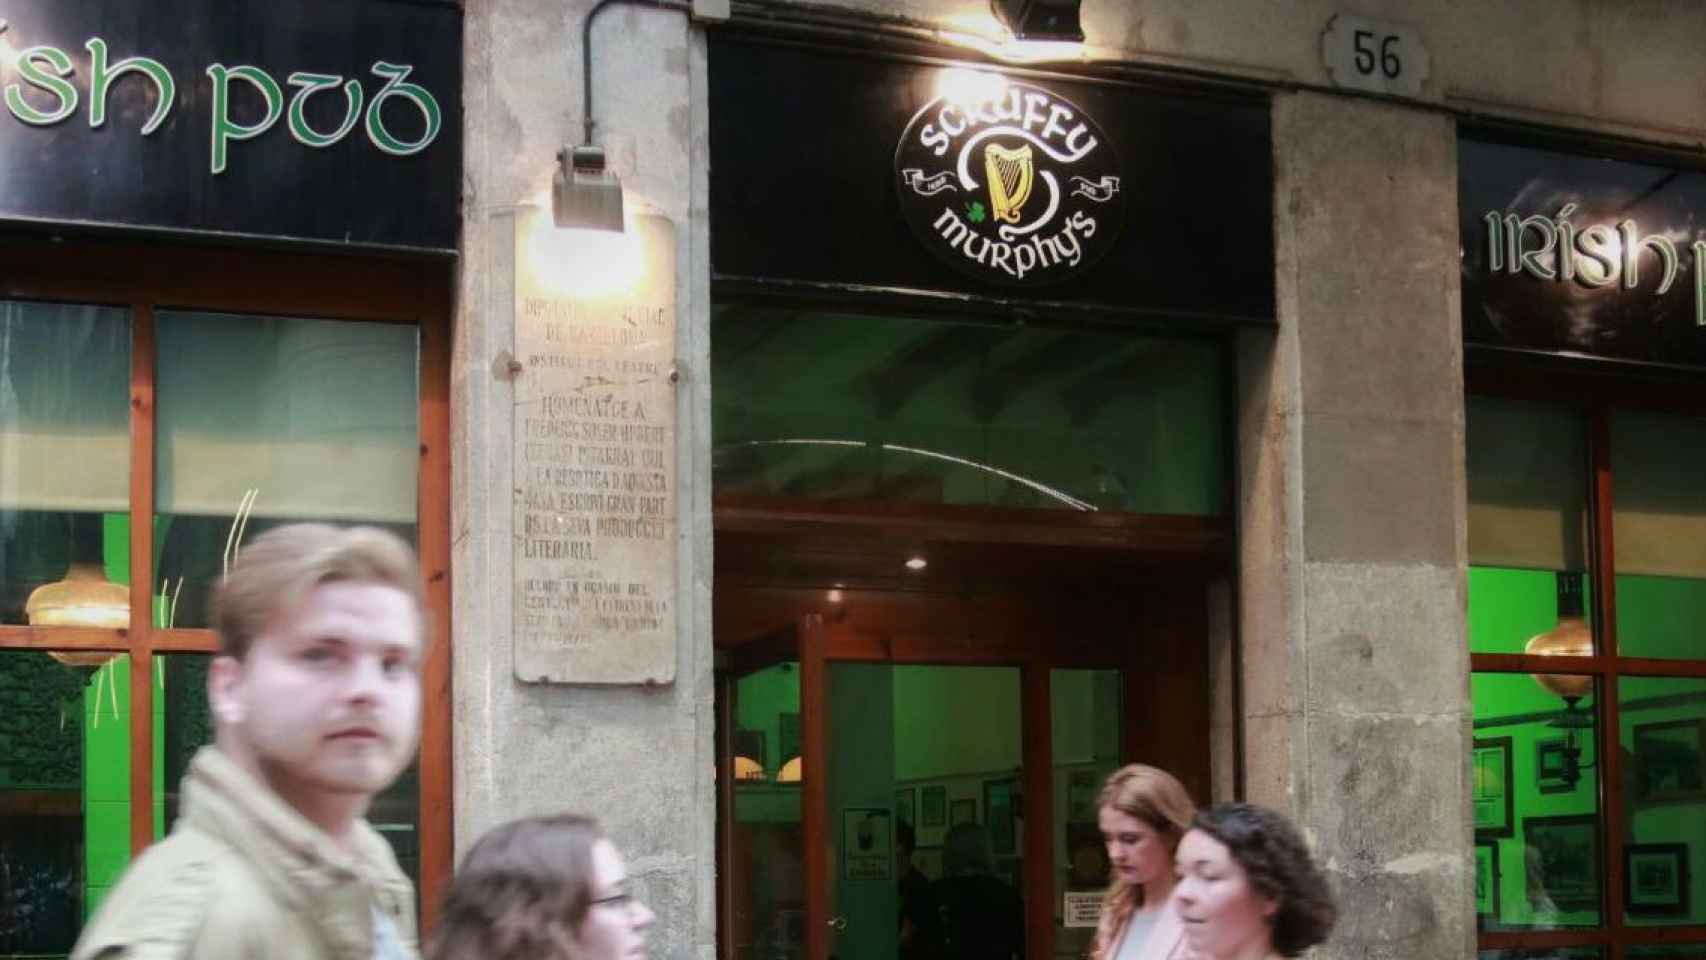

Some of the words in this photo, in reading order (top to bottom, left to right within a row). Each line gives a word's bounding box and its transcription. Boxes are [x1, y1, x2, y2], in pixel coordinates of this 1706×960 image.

[1353, 30, 1401, 79] 56
[0, 37, 176, 135] sh
[206, 61, 441, 174] pub
